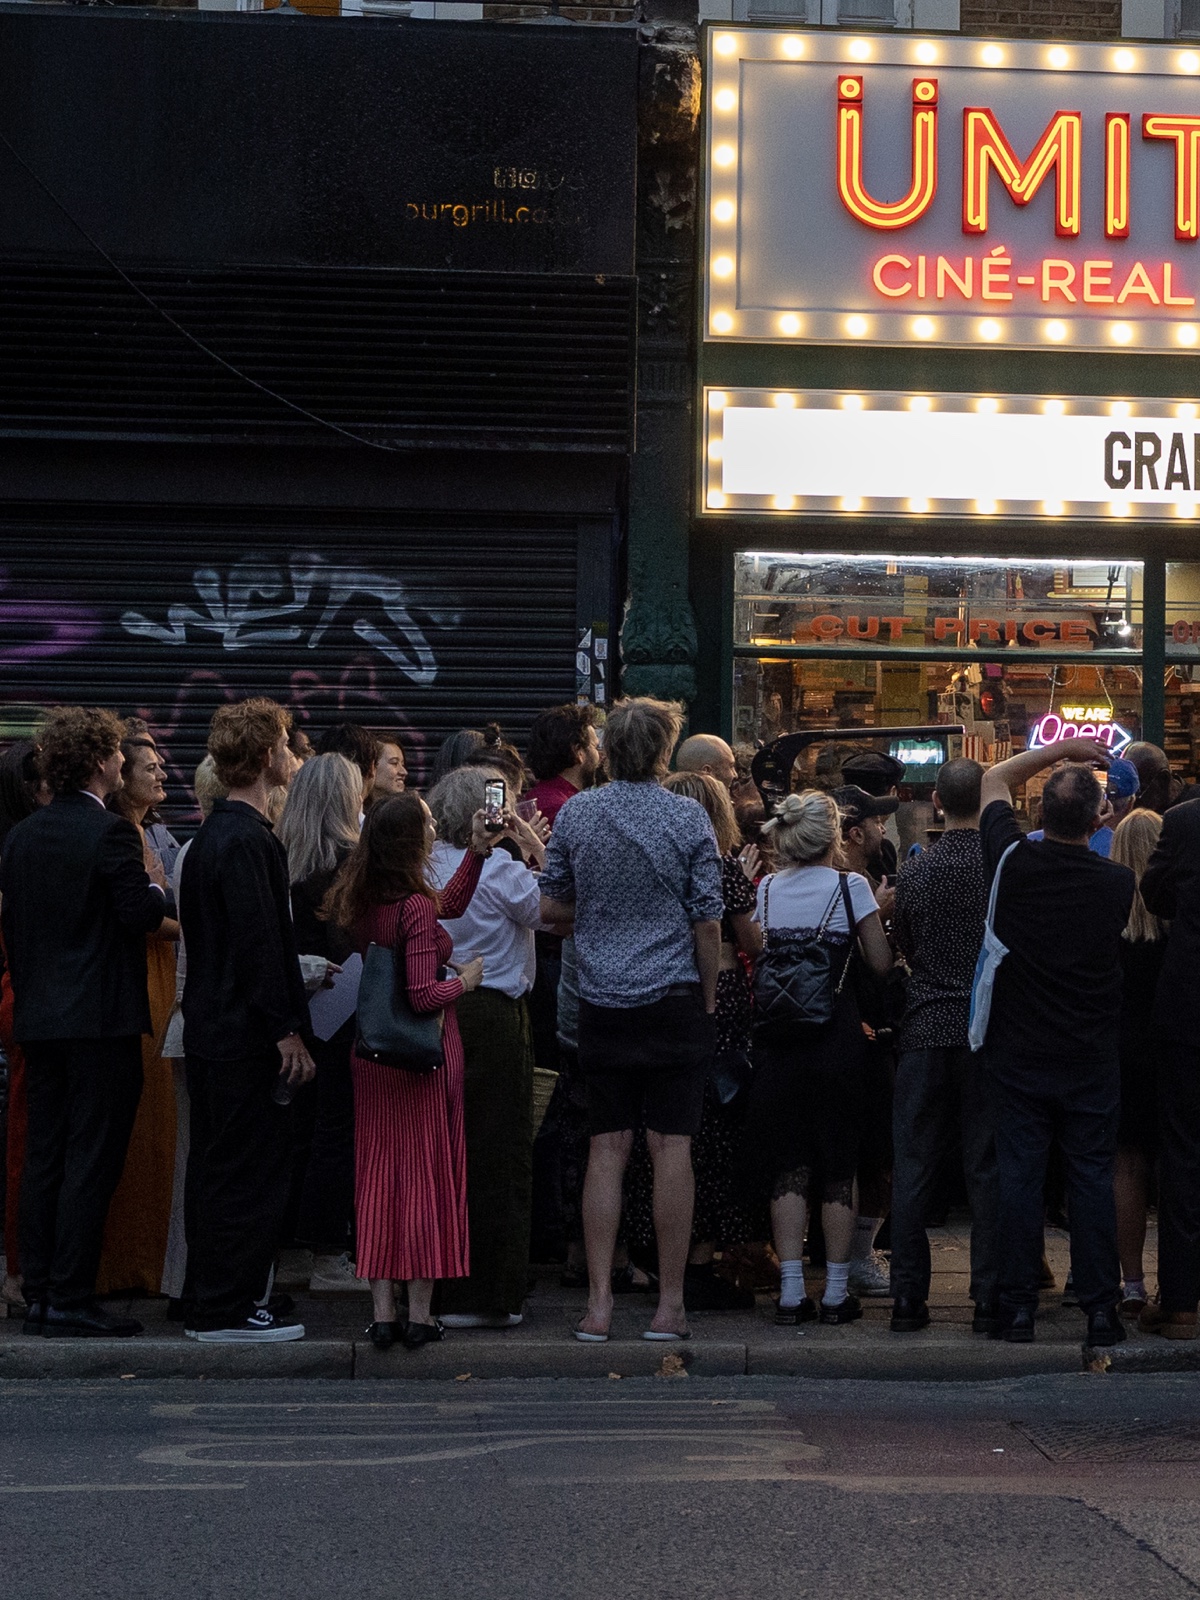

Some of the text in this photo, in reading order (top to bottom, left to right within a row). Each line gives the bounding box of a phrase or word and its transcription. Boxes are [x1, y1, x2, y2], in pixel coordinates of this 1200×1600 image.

[872, 246, 1195, 306] CINÉ-REAL
[810, 614, 1091, 642] CUT PRICE
[1061, 706, 1111, 722] WE ARE
